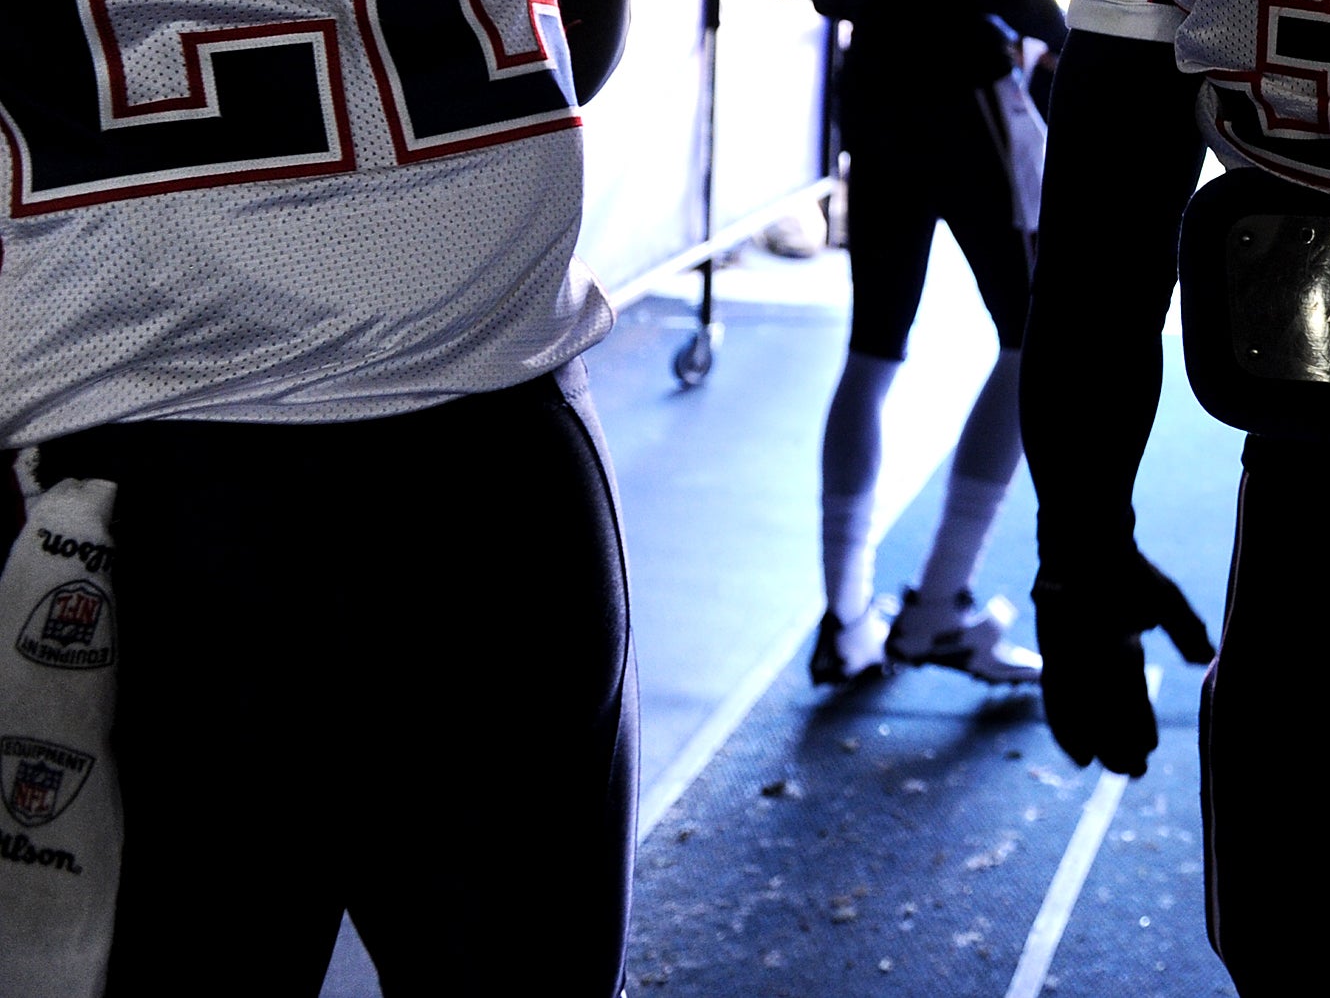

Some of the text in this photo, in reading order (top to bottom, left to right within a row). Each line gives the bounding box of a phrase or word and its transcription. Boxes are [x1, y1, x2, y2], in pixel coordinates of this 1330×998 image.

[40, 528, 115, 573] ilson
[56, 593, 102, 626] NFL
[21, 637, 110, 666] EQUIPMENT
[3, 740, 87, 773] EQUIPMENT
[15, 781, 49, 813] NFL
[0, 830, 76, 873] ilson
